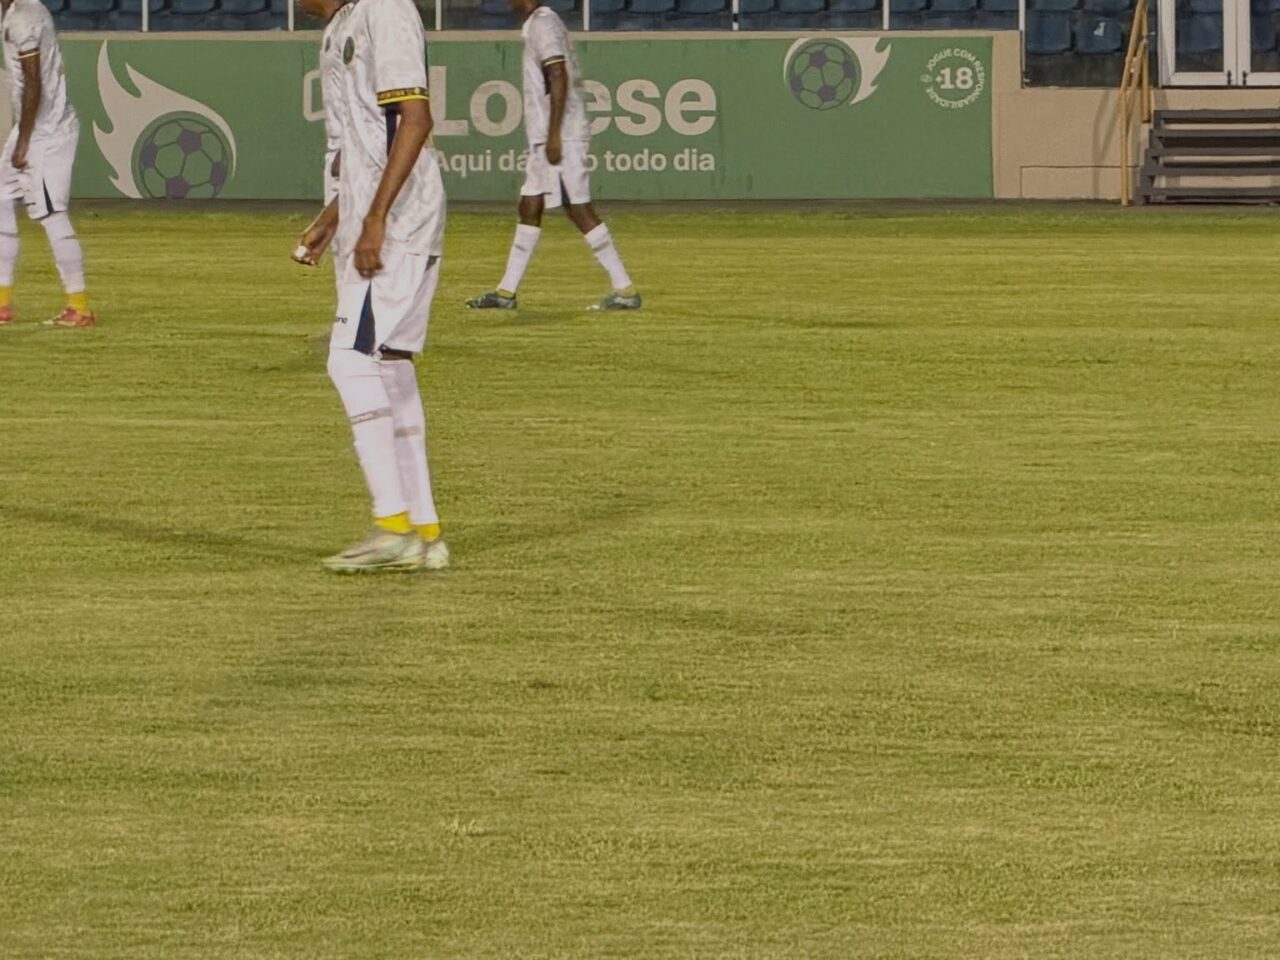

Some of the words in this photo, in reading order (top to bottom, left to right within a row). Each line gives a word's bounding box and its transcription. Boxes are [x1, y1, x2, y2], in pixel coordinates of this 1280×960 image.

[428, 65, 717, 136] Loese
[437, 149, 492, 178] Aqui
[603, 148, 668, 172] todo
[673, 148, 716, 172] dia
